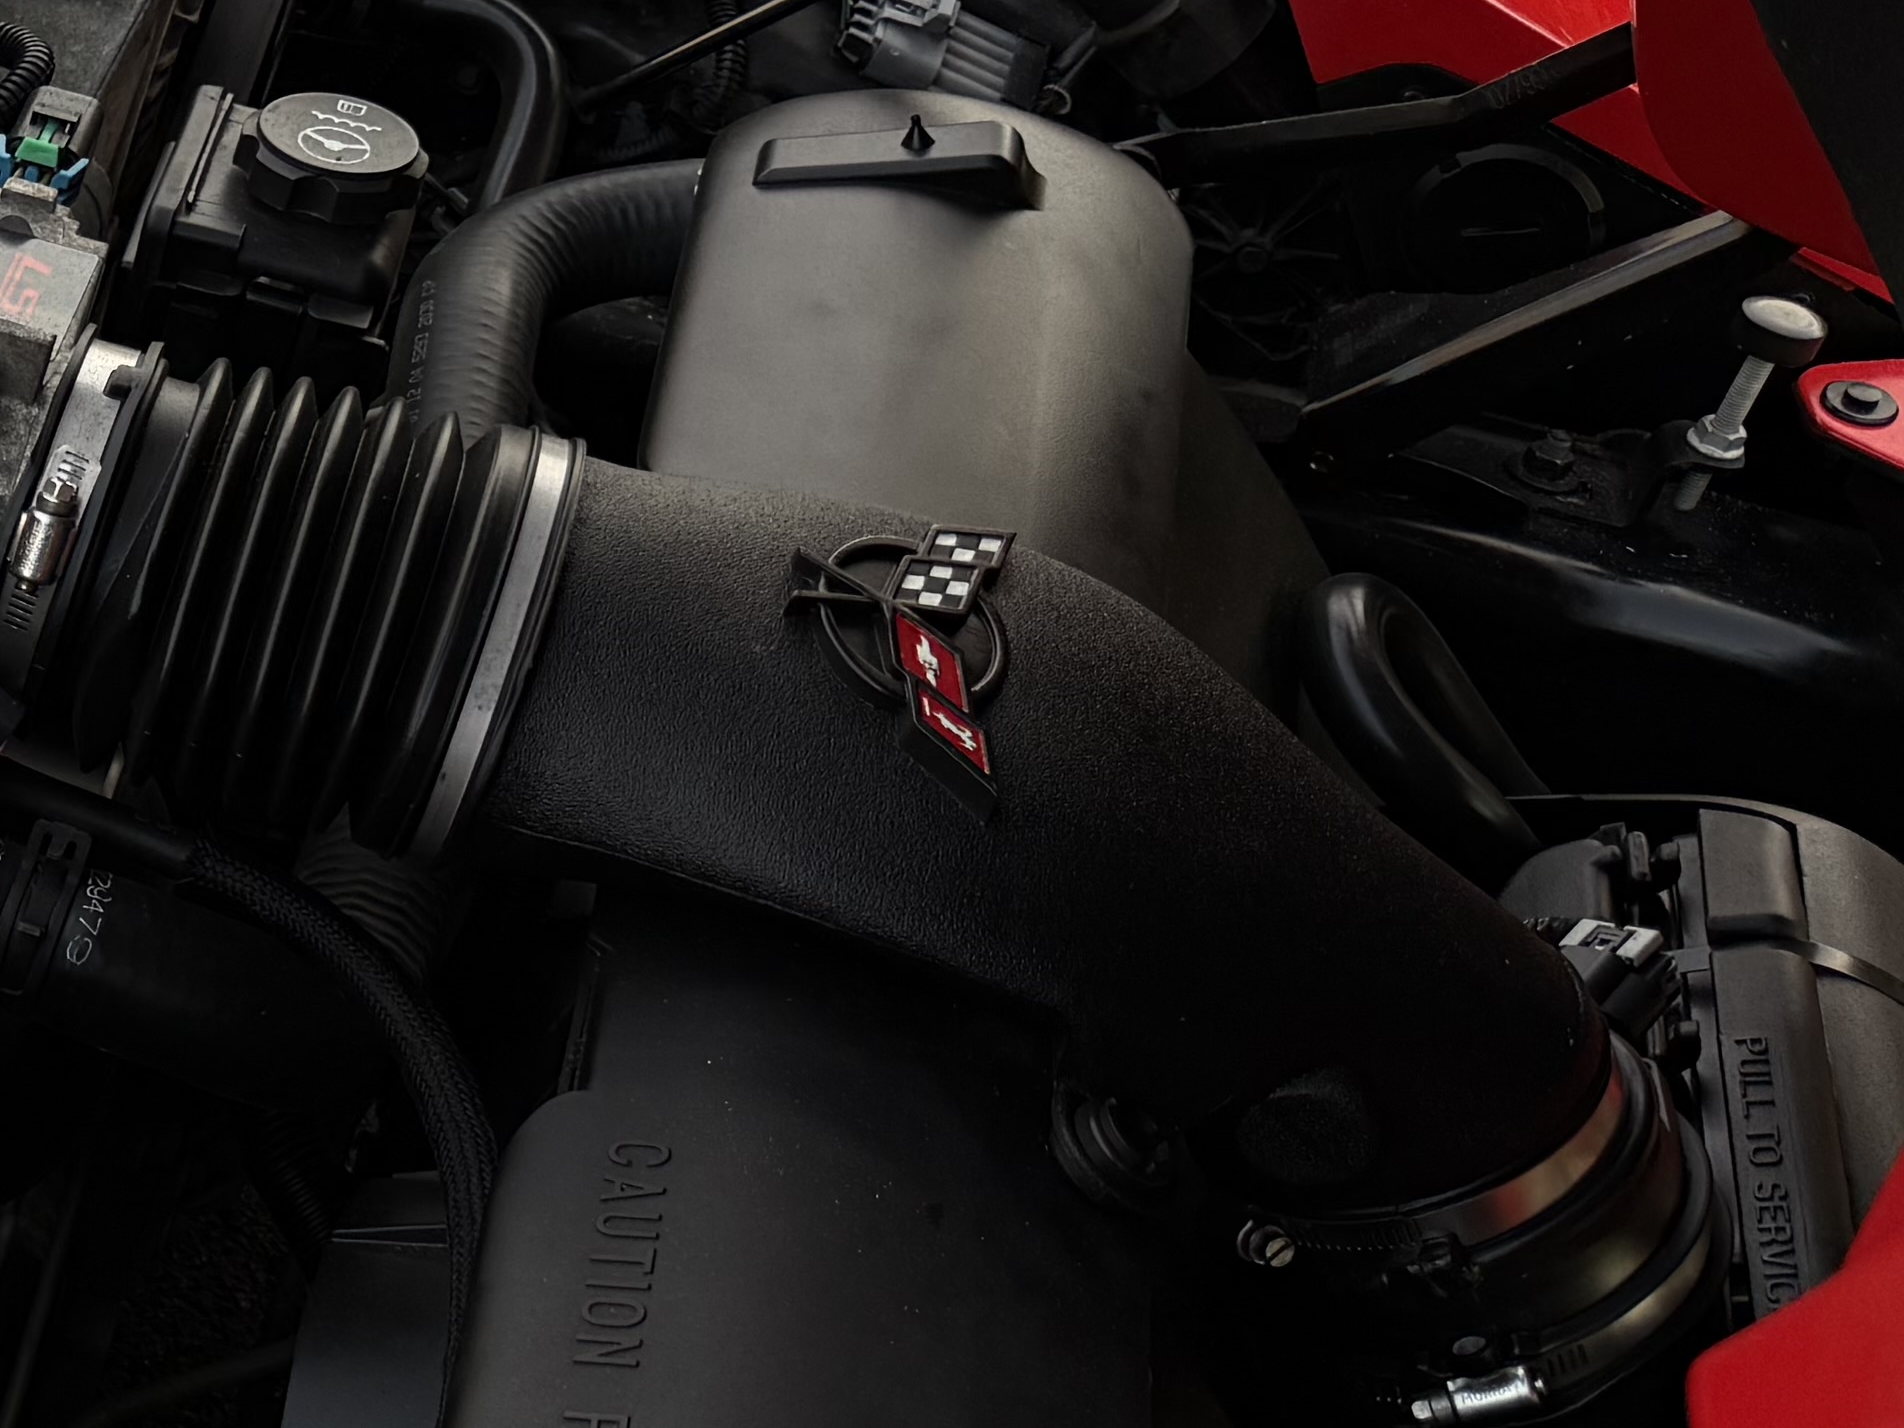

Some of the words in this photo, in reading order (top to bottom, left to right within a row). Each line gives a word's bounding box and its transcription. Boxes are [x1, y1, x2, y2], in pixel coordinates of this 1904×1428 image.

[1734, 1036, 1776, 1120] PULL
[1745, 1124, 1783, 1168] TO
[572, 1139, 672, 1369] CAUTION
[1754, 1180, 1799, 1314] SERVIC
